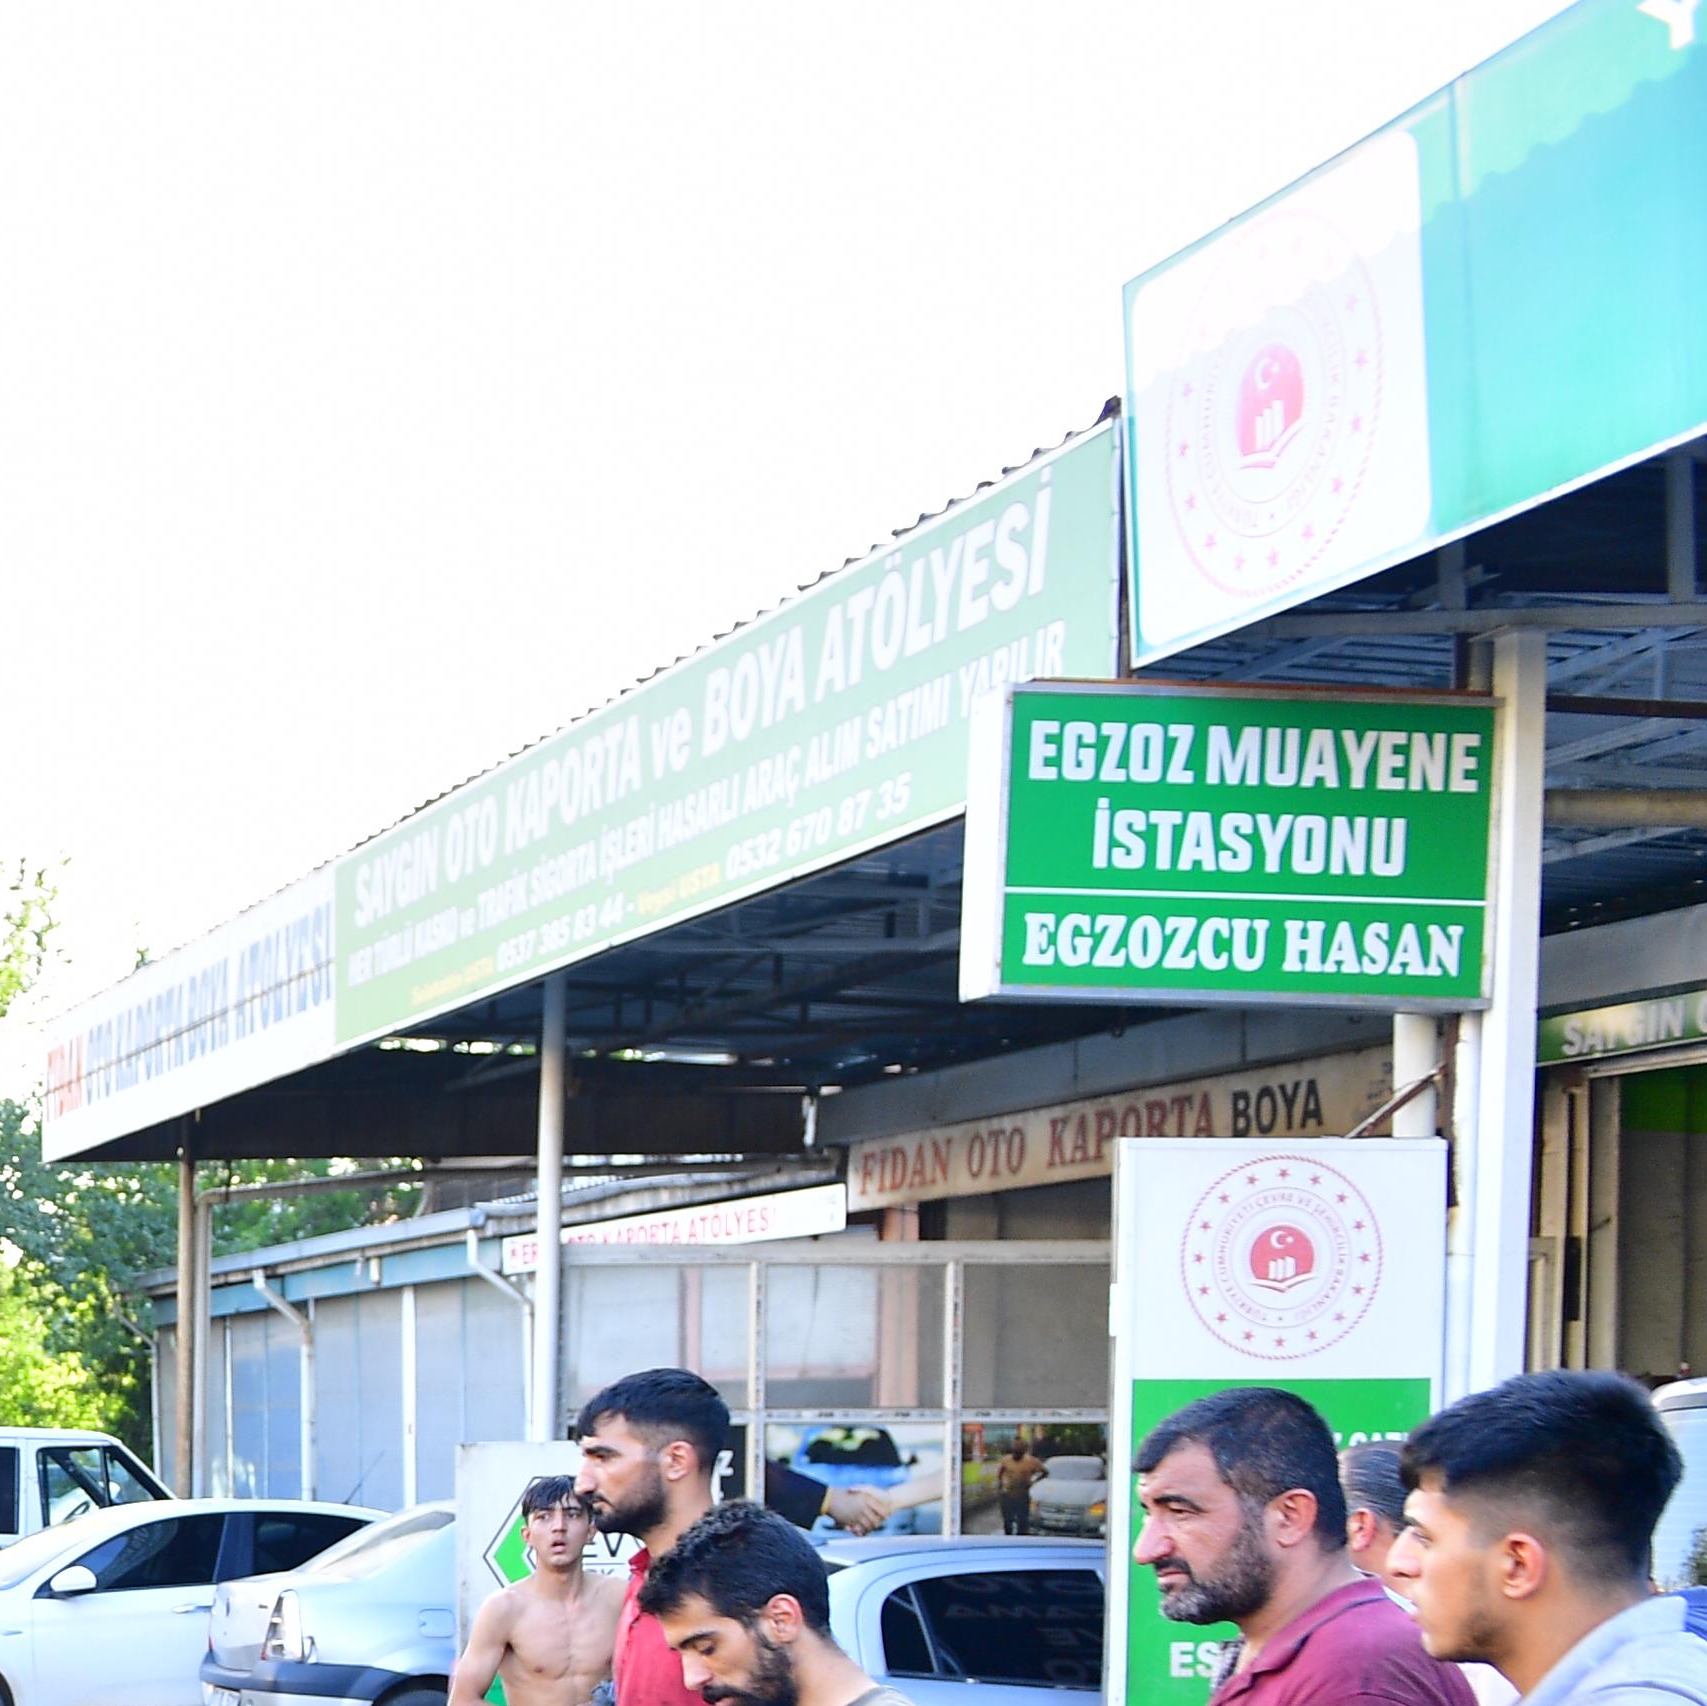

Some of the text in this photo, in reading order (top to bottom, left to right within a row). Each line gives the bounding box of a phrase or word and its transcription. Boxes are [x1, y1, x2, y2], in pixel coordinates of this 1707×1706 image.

[354, 465, 1053, 928] SAYGIN OTO KAPORTA ve BOYA ATÖLYESİ
[659, 774, 739, 851] HASARLI
[742, 746, 800, 808] ARAÇ
[865, 673, 951, 760] SATIMI
[1027, 720, 1482, 793] EGZOZ MUAYENE
[725, 825, 781, 882] 0532
[784, 804, 831, 858] 670
[838, 786, 873, 839] 87
[876, 771, 912, 823] 35
[1091, 797, 1408, 877] İSTASYONU
[1022, 912, 1465, 978] EGZOZCU HASAN
[1562, 1000, 1685, 1055] SAYGIN
[966, 1125, 1027, 1178] OTO
[1047, 1091, 1215, 1169] KAPORTA
[1230, 1078, 1326, 1139] BOYA
